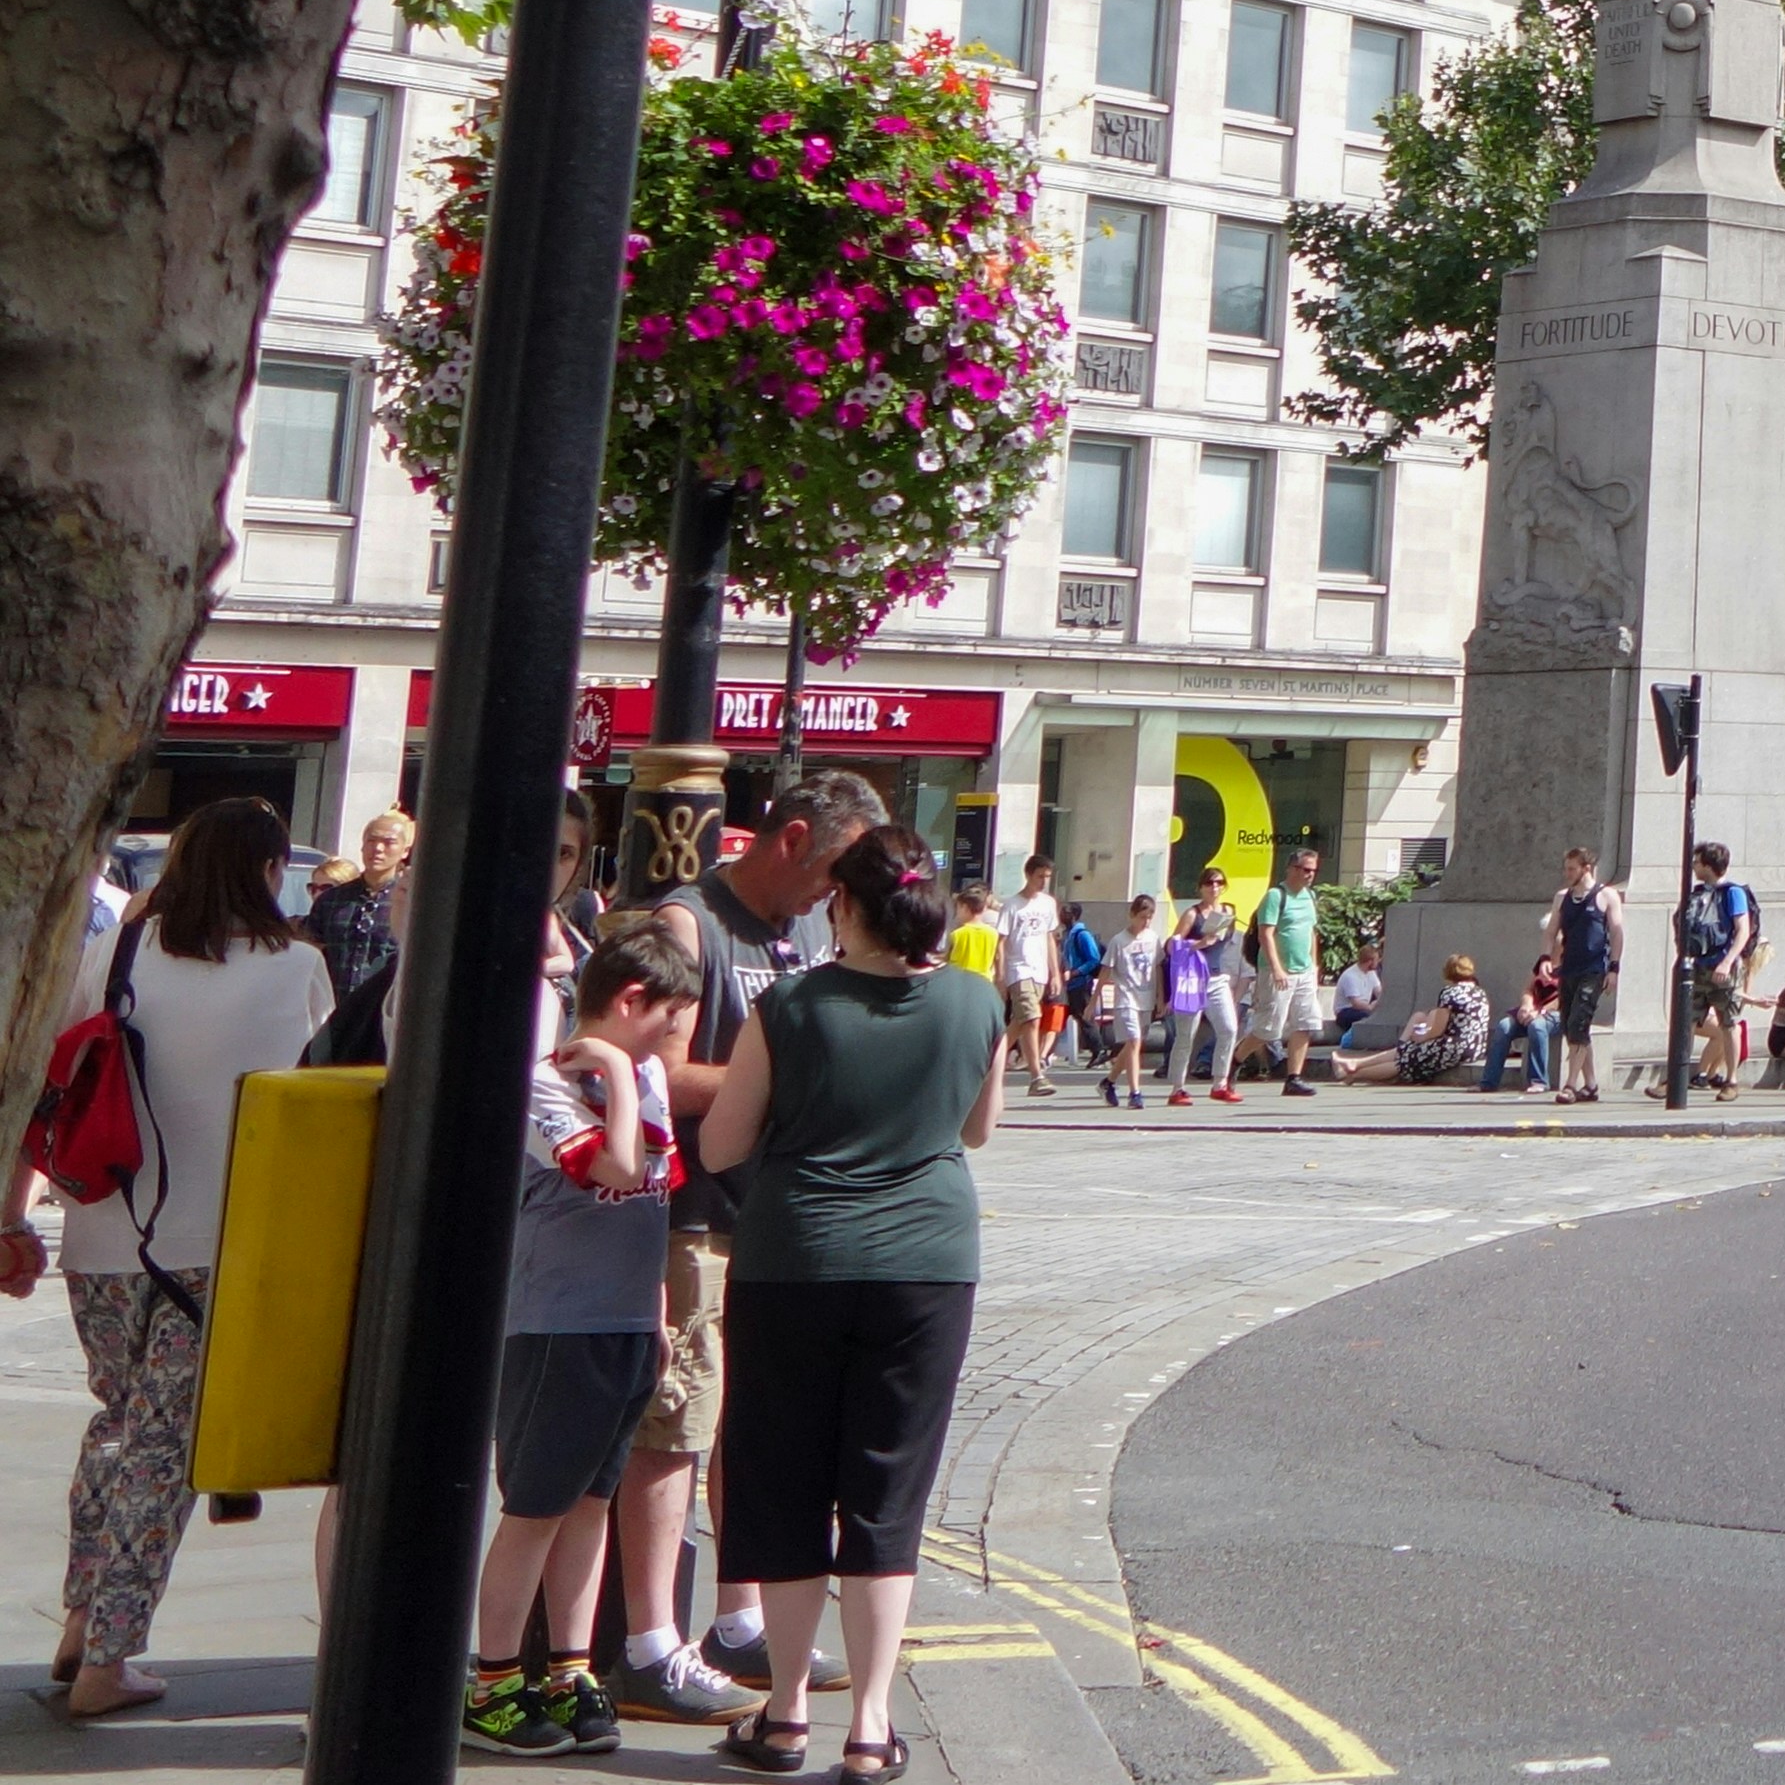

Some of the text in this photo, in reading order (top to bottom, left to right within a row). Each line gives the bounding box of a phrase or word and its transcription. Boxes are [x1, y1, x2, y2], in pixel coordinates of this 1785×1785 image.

[1520, 310, 1634, 349] FORTITUDE
[1184, 677, 1233, 690] NUMBER
[1239, 679, 1275, 692] SEVEN
[1356, 683, 1390, 696] PLACE
[719, 692, 775, 729] PRET
[800, 696, 880, 732] MANGER
[1237, 829, 1303, 846] Redwood
